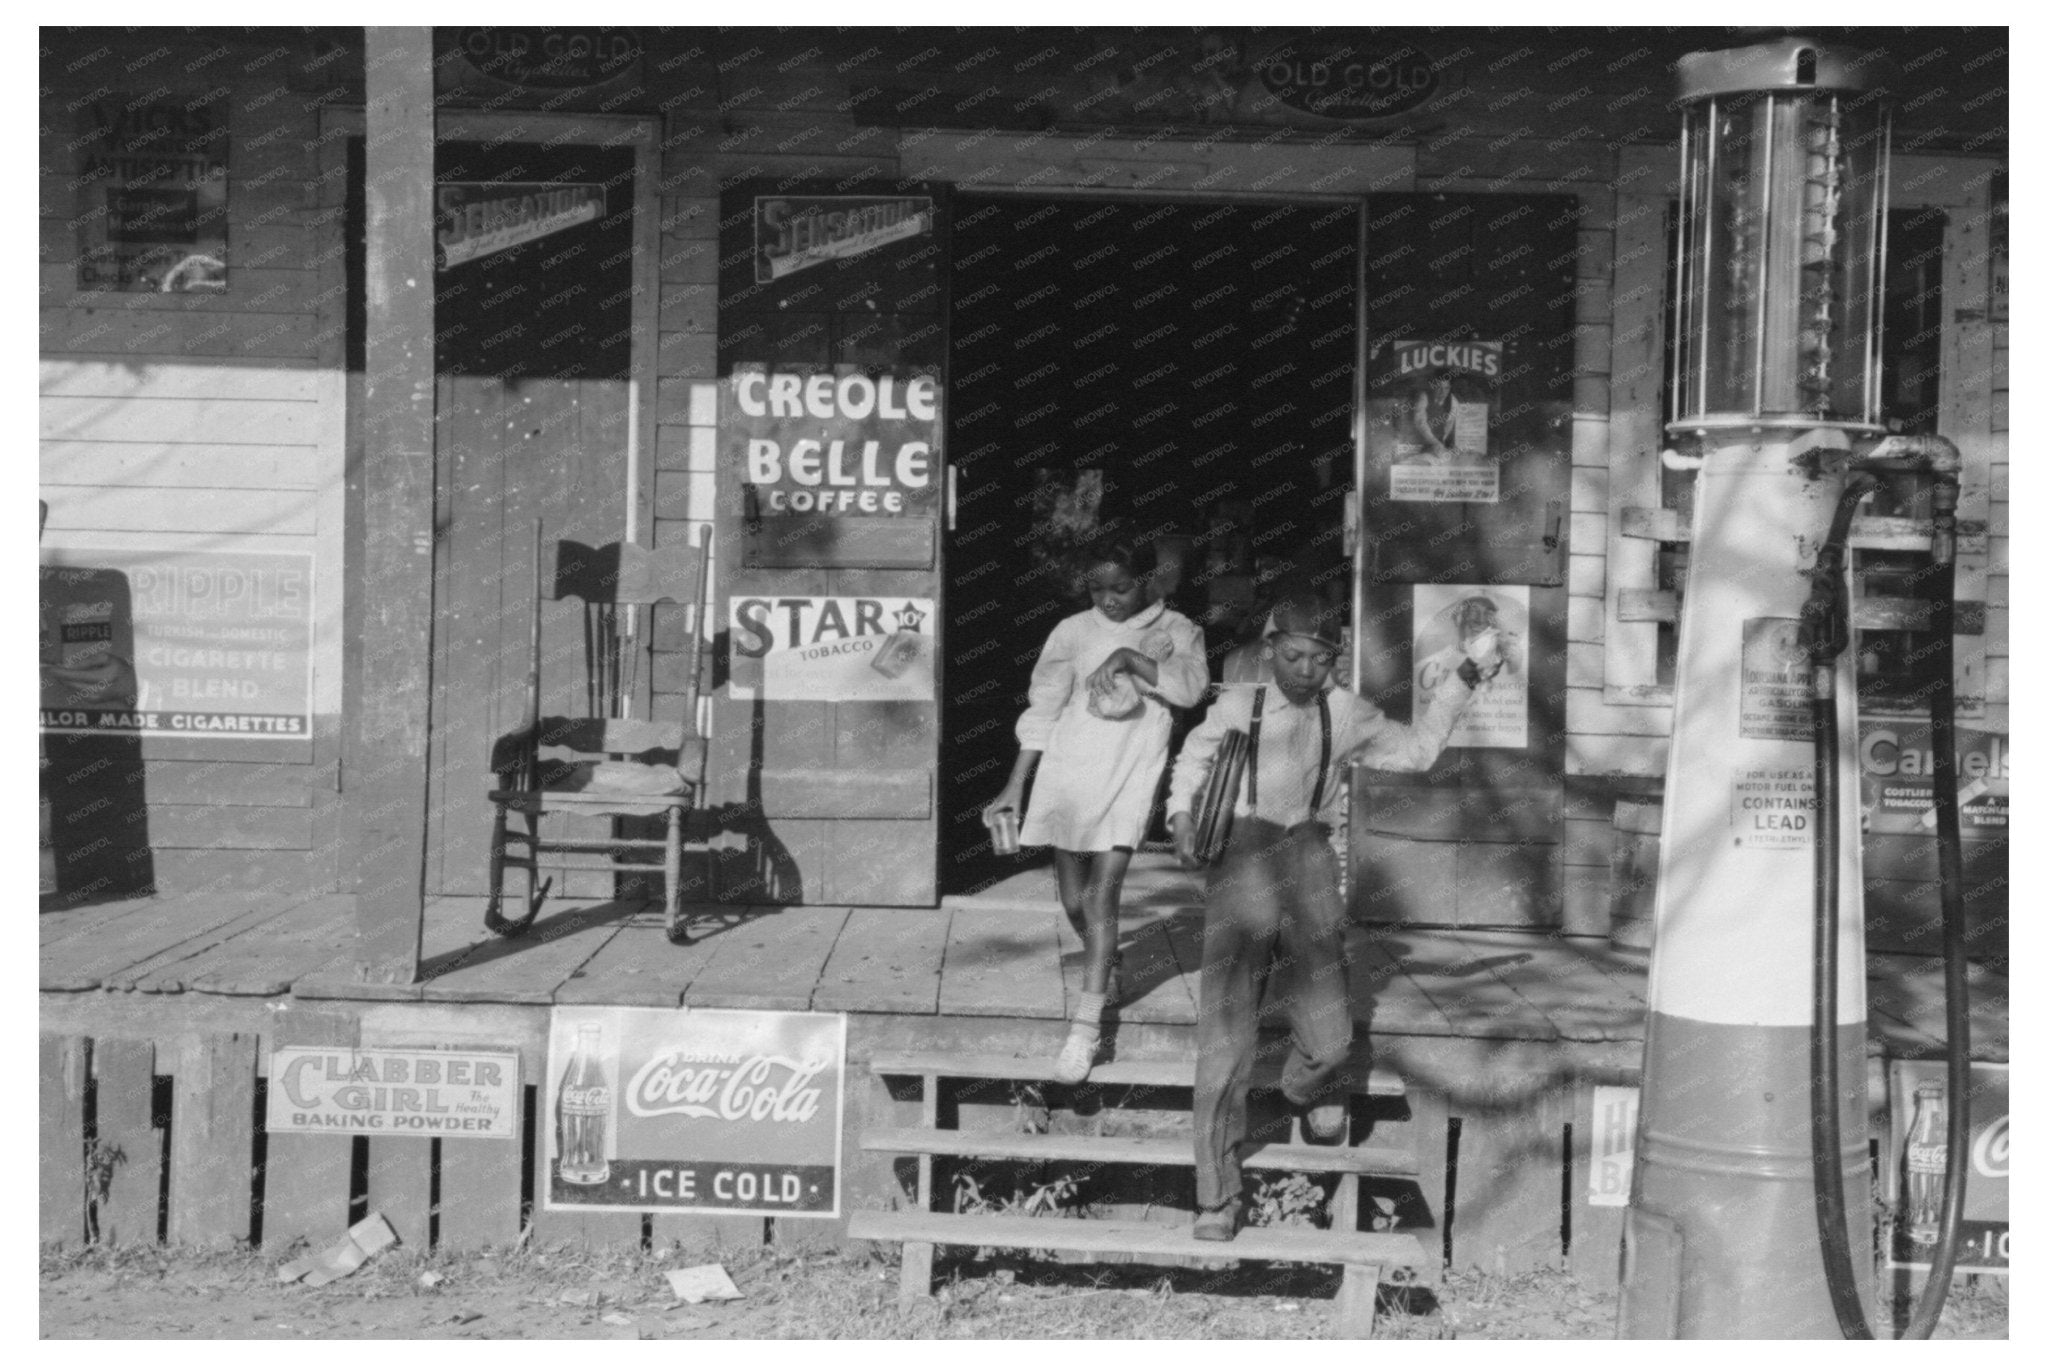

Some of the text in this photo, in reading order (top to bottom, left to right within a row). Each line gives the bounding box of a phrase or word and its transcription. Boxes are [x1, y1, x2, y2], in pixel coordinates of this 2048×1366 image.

[467, 32, 631, 59] OLD GOLD
[1268, 61, 1431, 89] OLD GOLD
[1401, 344, 1499, 376] LUCKIES
[737, 371, 936, 421] CREOLE
[747, 437, 930, 489] BELLE
[769, 490, 903, 514] COFFEE
[129, 566, 301, 618] RIPPLE
[149, 624, 204, 638] TURKISH
[221, 626, 289, 641] DOMESTIC
[736, 599, 887, 659] STAR
[149, 649, 288, 670] CIGARETTE
[800, 639, 874, 662] TOBACCO
[172, 678, 260, 700] BLEND
[99, 713, 159, 728] MADE
[171, 715, 300, 732] CIGARETTES
[1736, 783, 1771, 791] MOTOR
[1774, 783, 1798, 792] FUEL
[1742, 796, 1816, 810] CONTAINS
[1755, 814, 1807, 831] LEAD
[1973, 816, 2007, 826] BLEND
[281, 1055, 502, 1109] CLABBER
[331, 1085, 450, 1114] GIRL
[471, 1090, 490, 1102] The
[455, 1102, 501, 1118] Healthy
[292, 1113, 493, 1131] BAKING POWDER
[639, 1169, 801, 1203] ICE COLD
